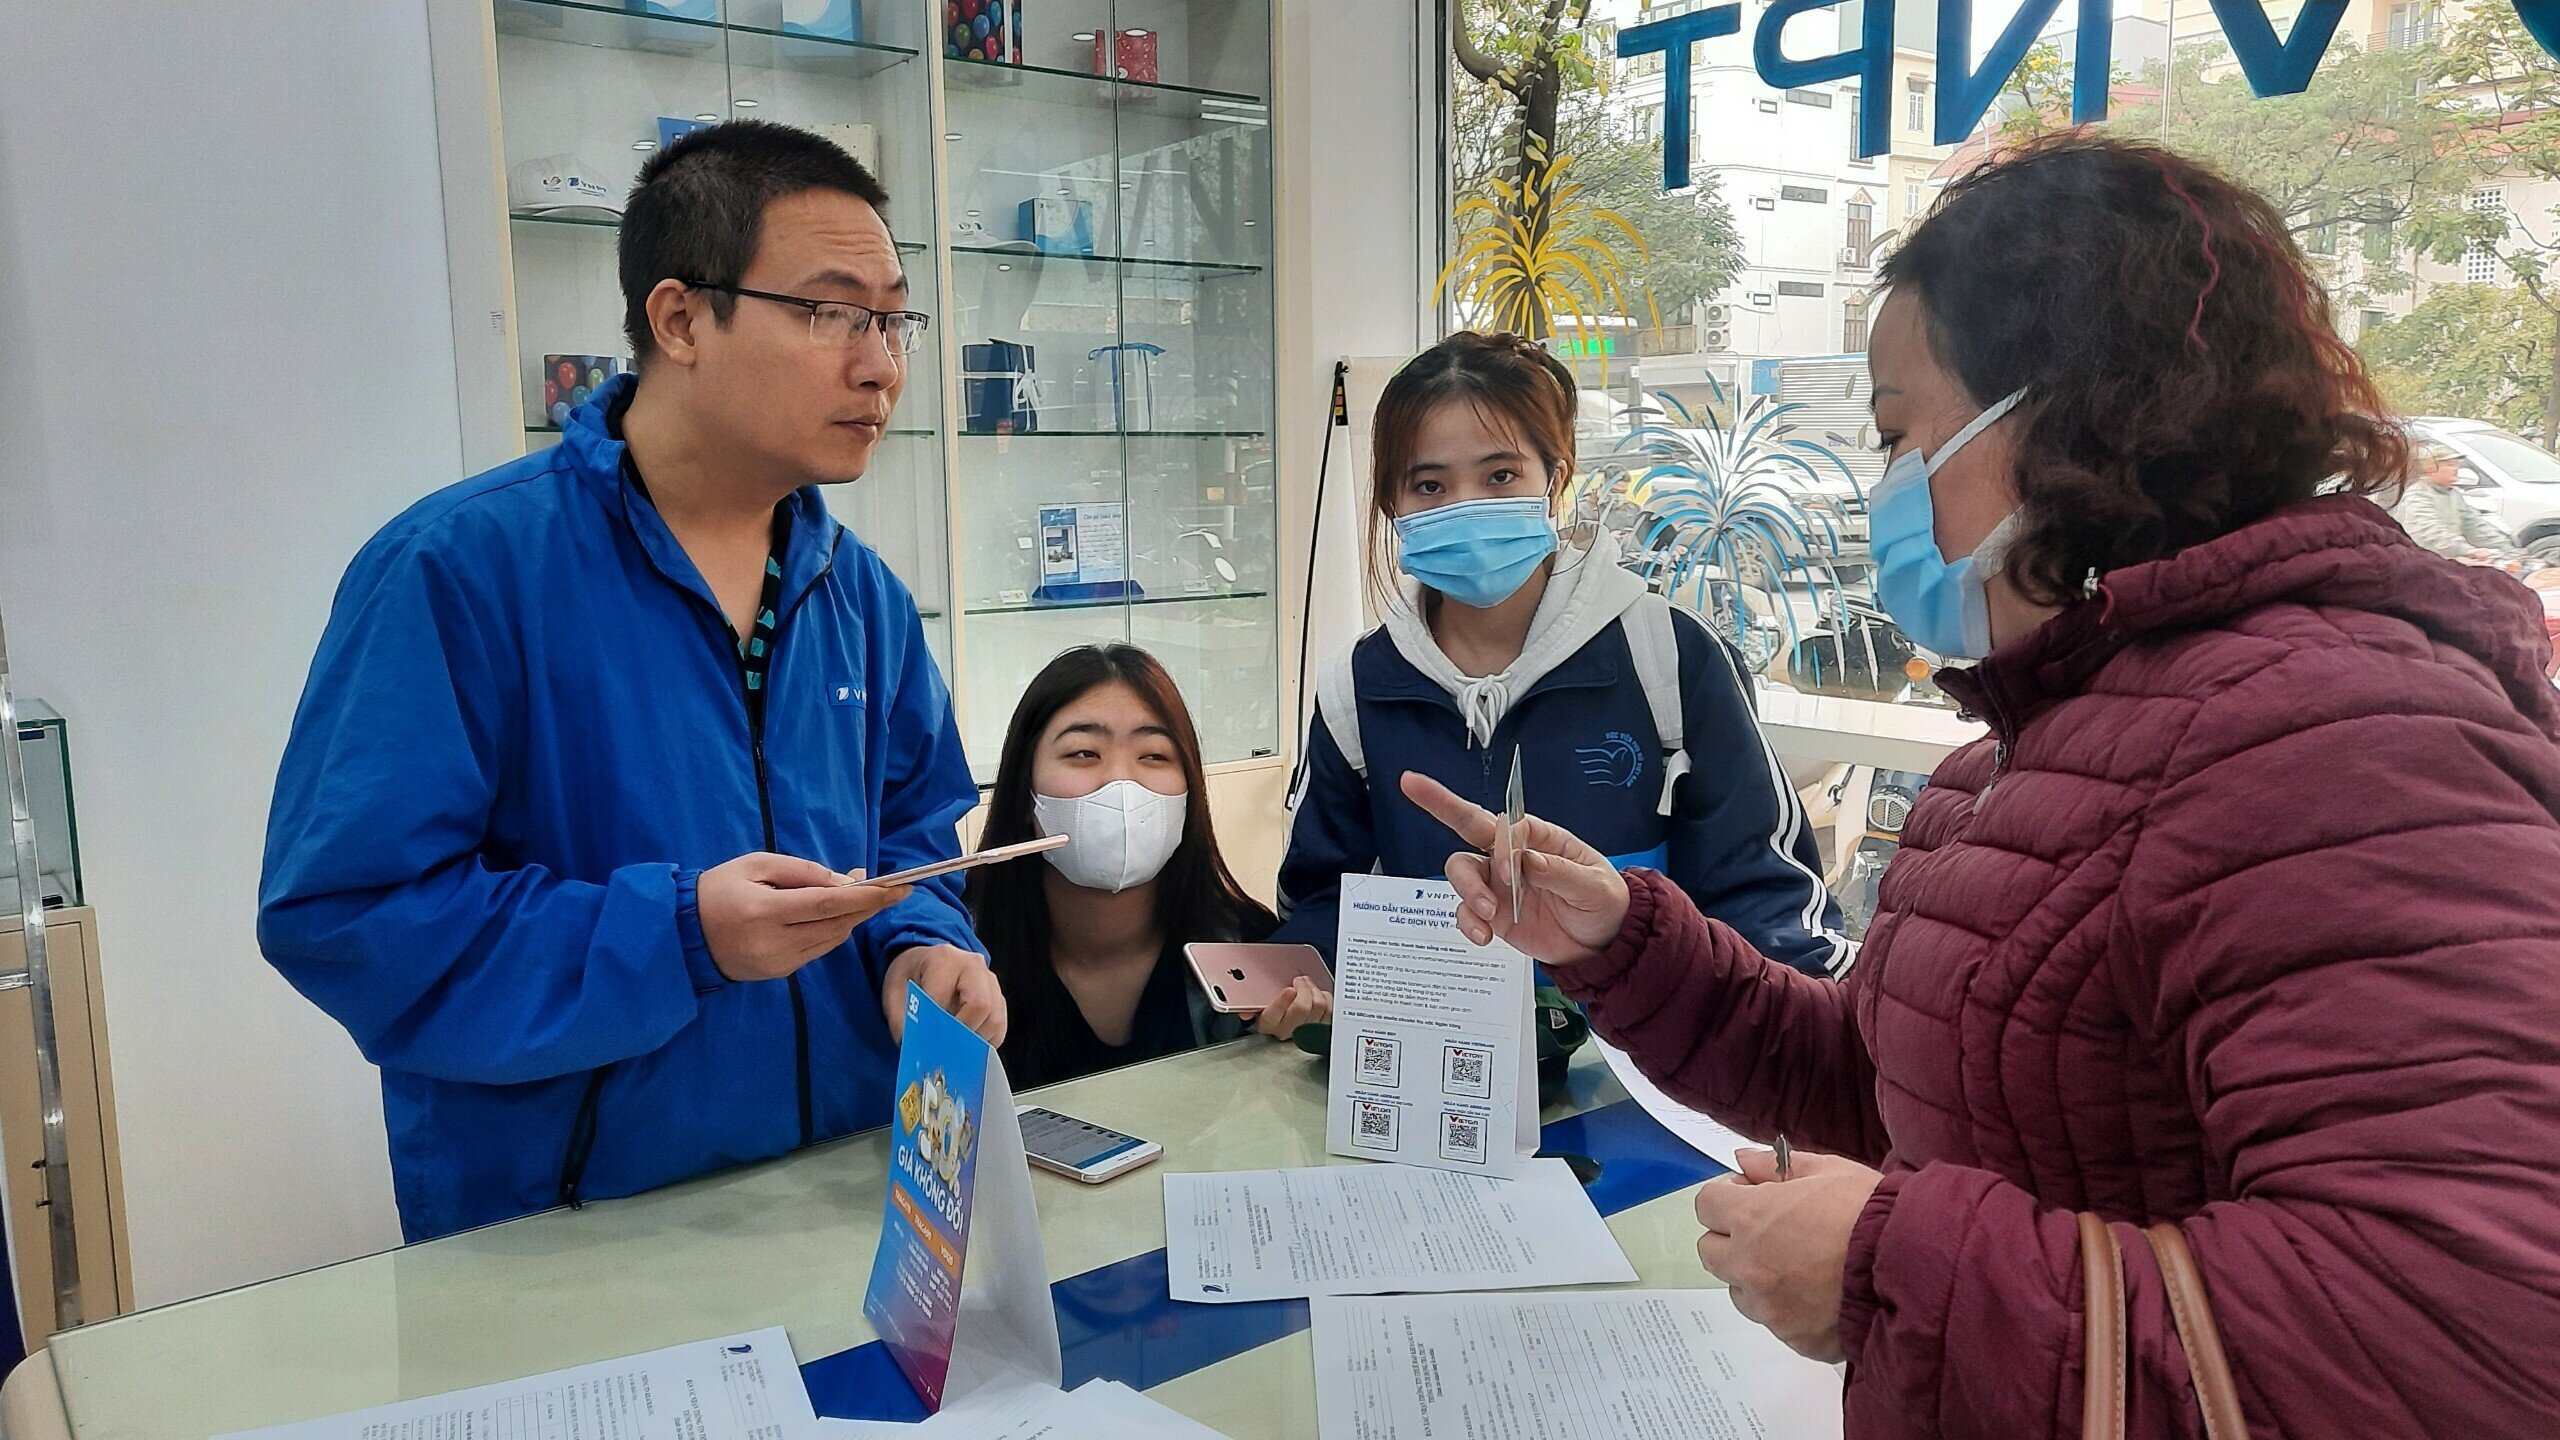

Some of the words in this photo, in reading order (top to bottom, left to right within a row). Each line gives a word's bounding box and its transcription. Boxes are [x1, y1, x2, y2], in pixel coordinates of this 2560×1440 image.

[1426, 892, 1456, 900] VNPT
[1400, 907, 1424, 915] THANH
[1426, 909, 1446, 917] TOÁN
[1389, 916, 1405, 924] CÁC
[898, 1144, 914, 1178] GIÁ
[913, 1160, 946, 1213] KHÔNG
[945, 1197, 964, 1236] ĐỔI
